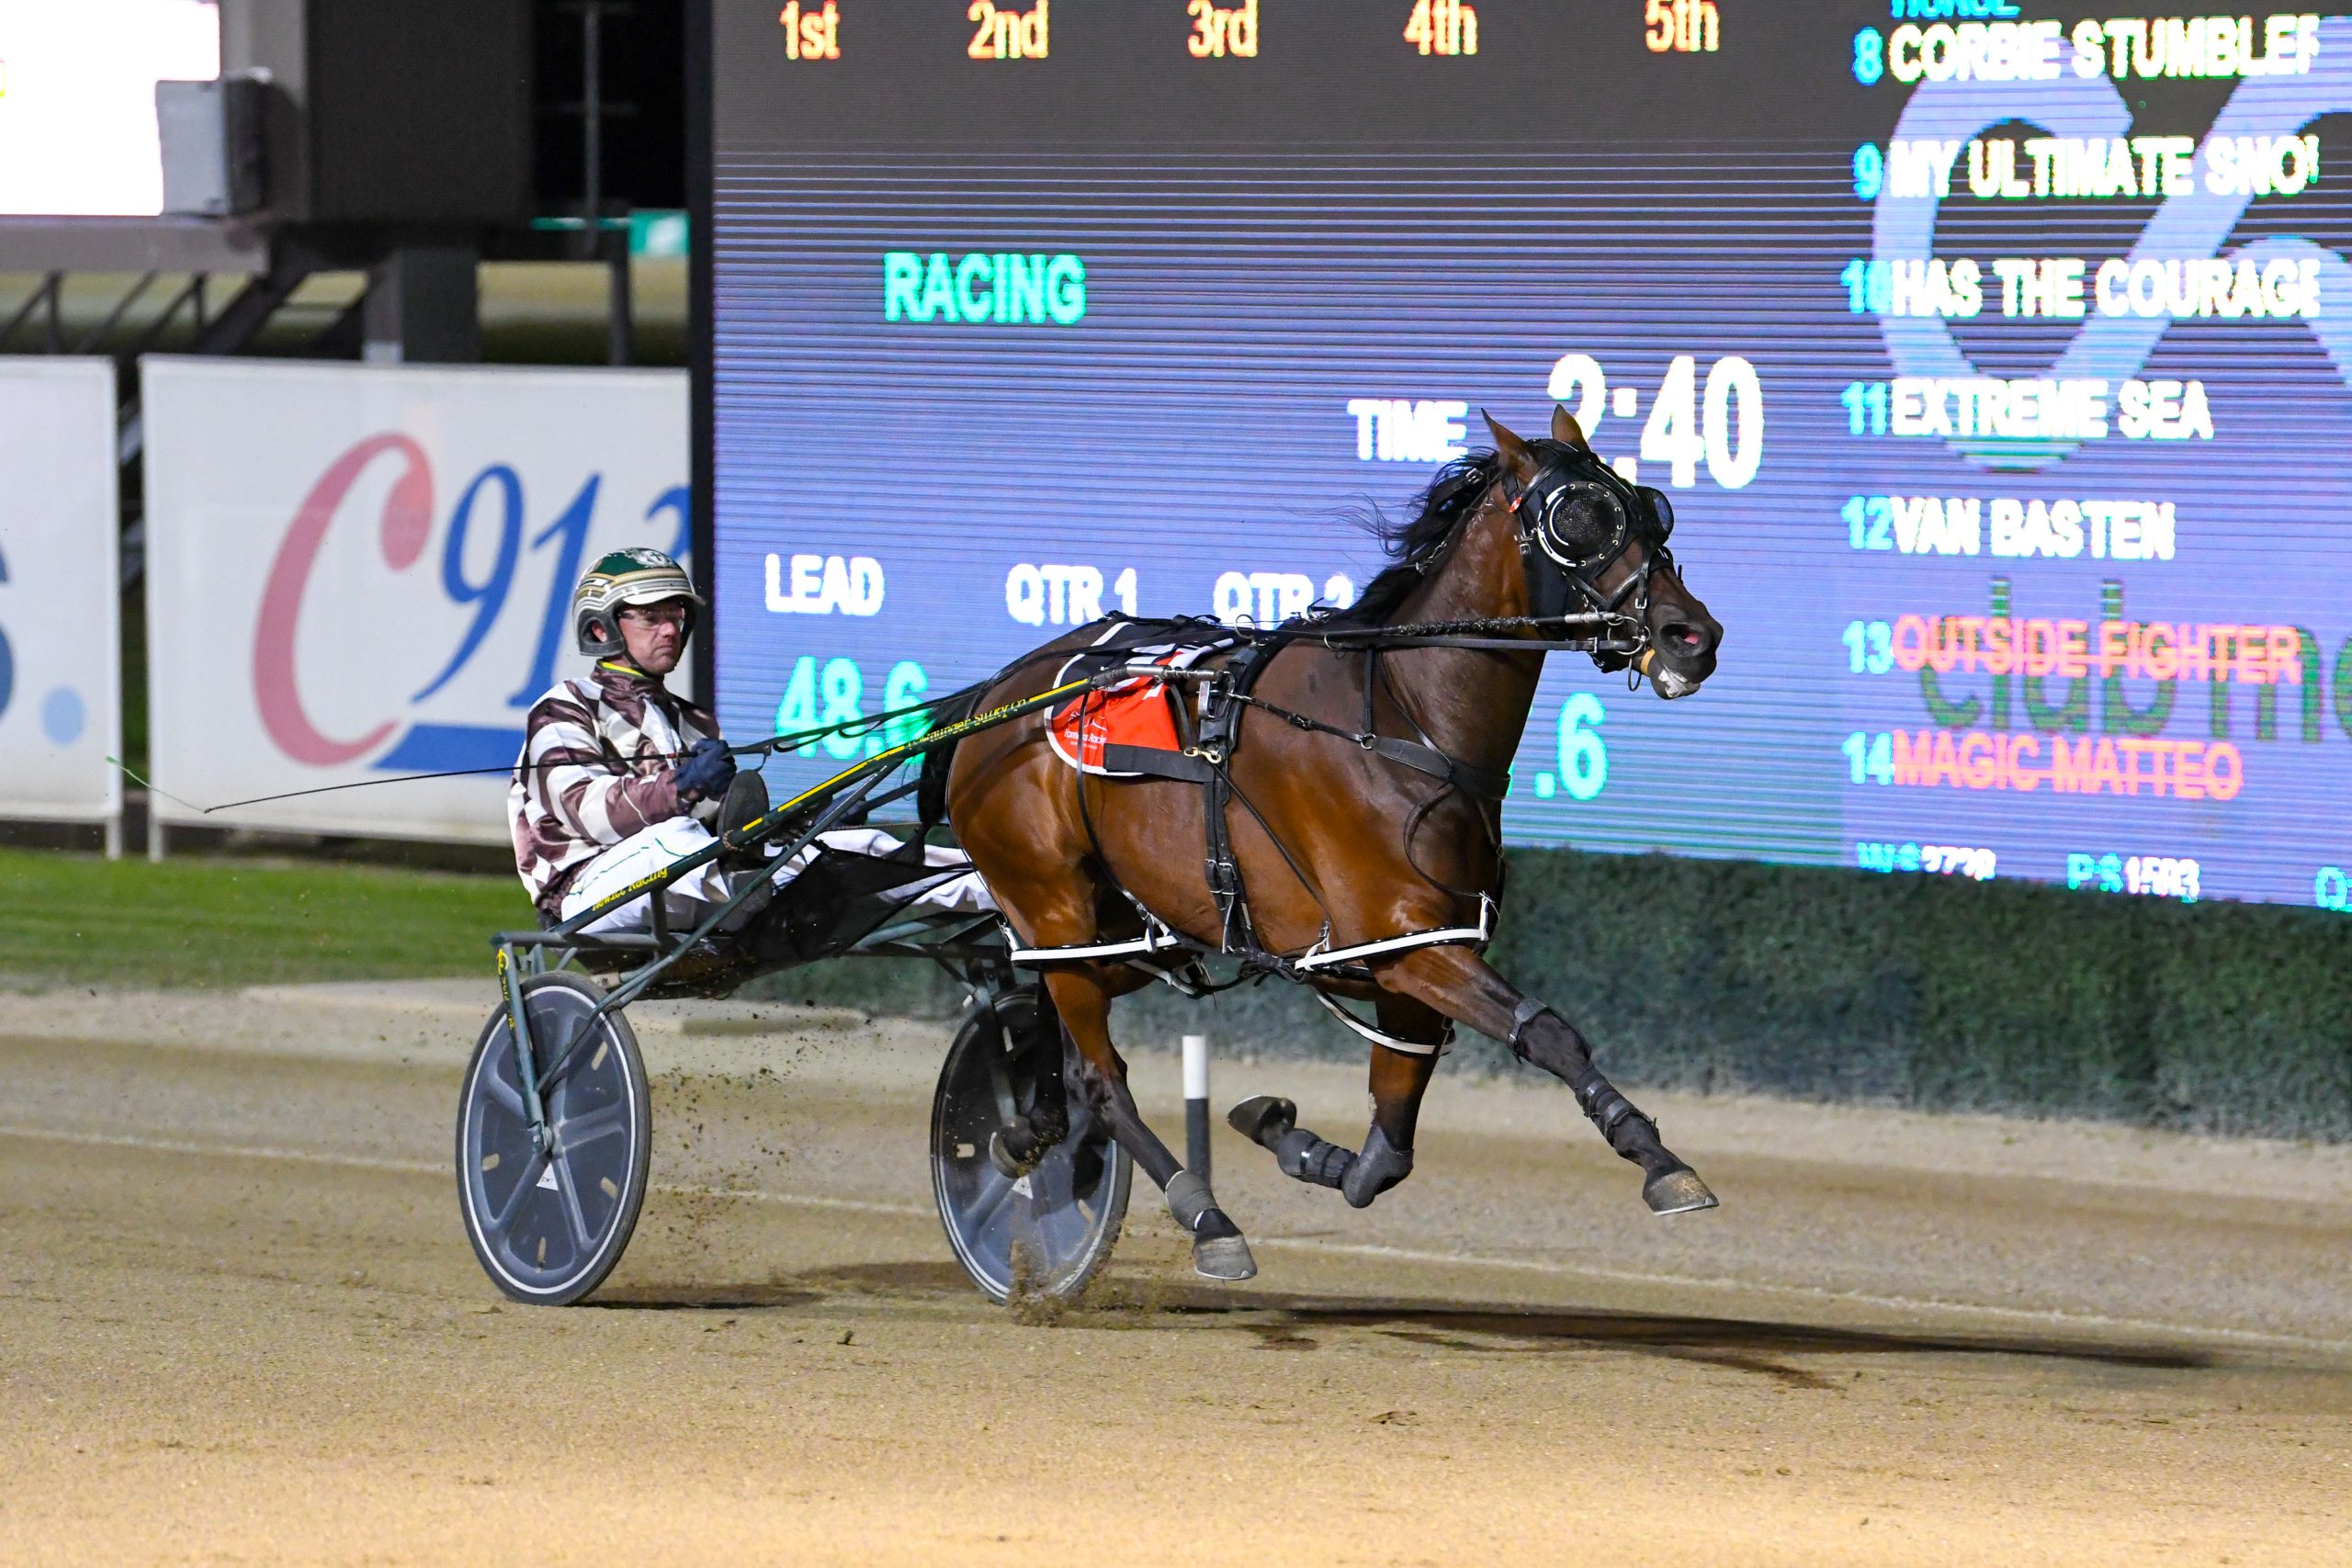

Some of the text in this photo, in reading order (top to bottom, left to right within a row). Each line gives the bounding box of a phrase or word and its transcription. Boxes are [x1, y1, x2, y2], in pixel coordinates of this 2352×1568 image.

[779, 0, 1720, 60] 1st 2nd 3rd 4th 5th
[1851, 26, 1883, 85] 8
[1888, 20, 2064, 84] CORBIE
[1852, 141, 1883, 200] 9
[1889, 139, 1957, 197] MY
[1967, 136, 2196, 198] ULTIMATE
[882, 252, 1088, 325] RACING
[1840, 257, 2321, 318] 10 HAS THE COURAGE
[1347, 354, 1765, 490] TIME 2:40
[1841, 378, 2215, 440] 11 EXTREME SEA
[1841, 496, 2177, 560] 12 VAN BASTEN
[764, 553, 886, 616] LEAD
[1005, 563, 1138, 625] QTR 1
[1213, 571, 1318, 630] QTR
[1842, 615, 2302, 684] 13 OUTSIDE FIGHTER
[775, 655, 932, 763] 48.6
[1842, 728, 2245, 801] 14 MAGIC MATTEO
